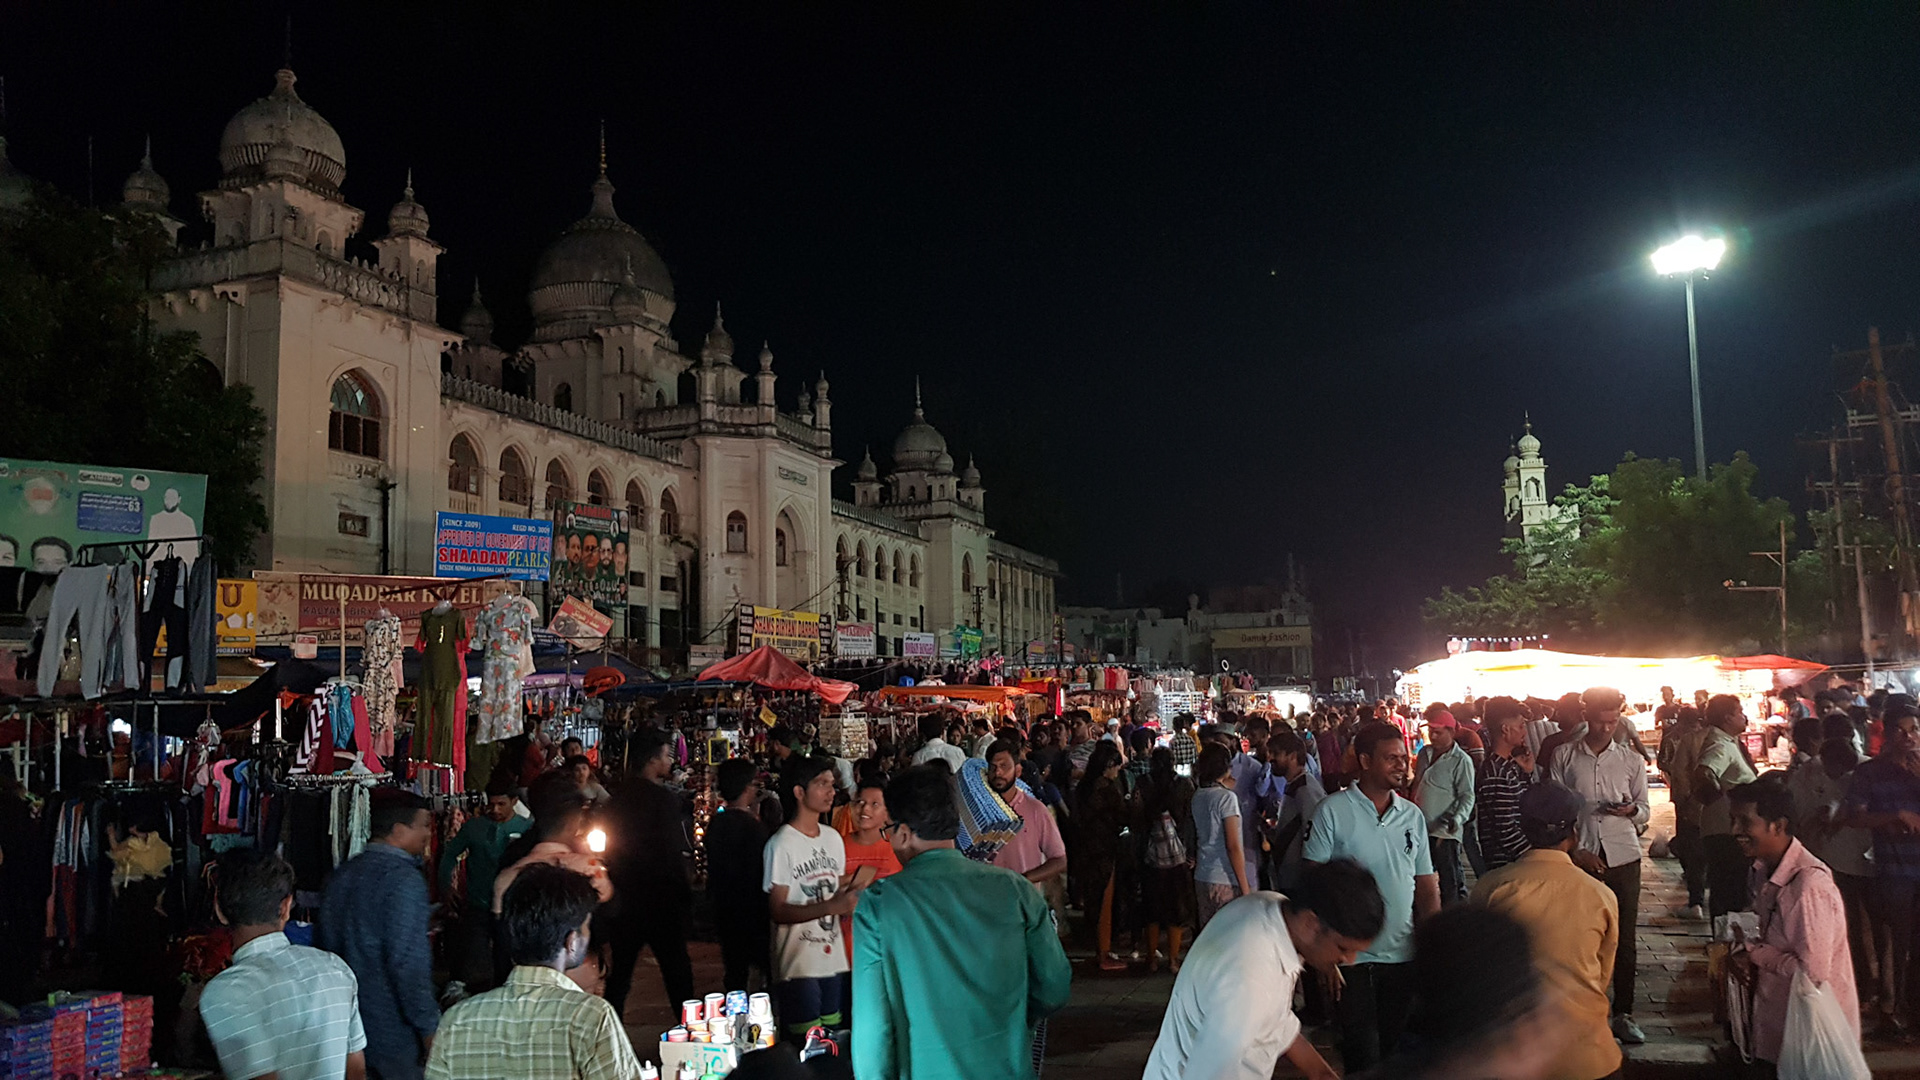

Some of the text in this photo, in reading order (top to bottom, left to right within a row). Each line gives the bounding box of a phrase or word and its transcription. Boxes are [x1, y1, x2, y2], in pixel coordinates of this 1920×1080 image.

[442, 518, 481, 530] (SINCE 2009)
[438, 529, 475, 548] APPROVED
[476, 531, 486, 548] BY
[486, 532, 529, 550] GOVERNMENT
[529, 535, 538, 551] OF
[438, 547, 549, 568] SHAADAN PEARLS
[1269, 632, 1300, 642] Fashion
